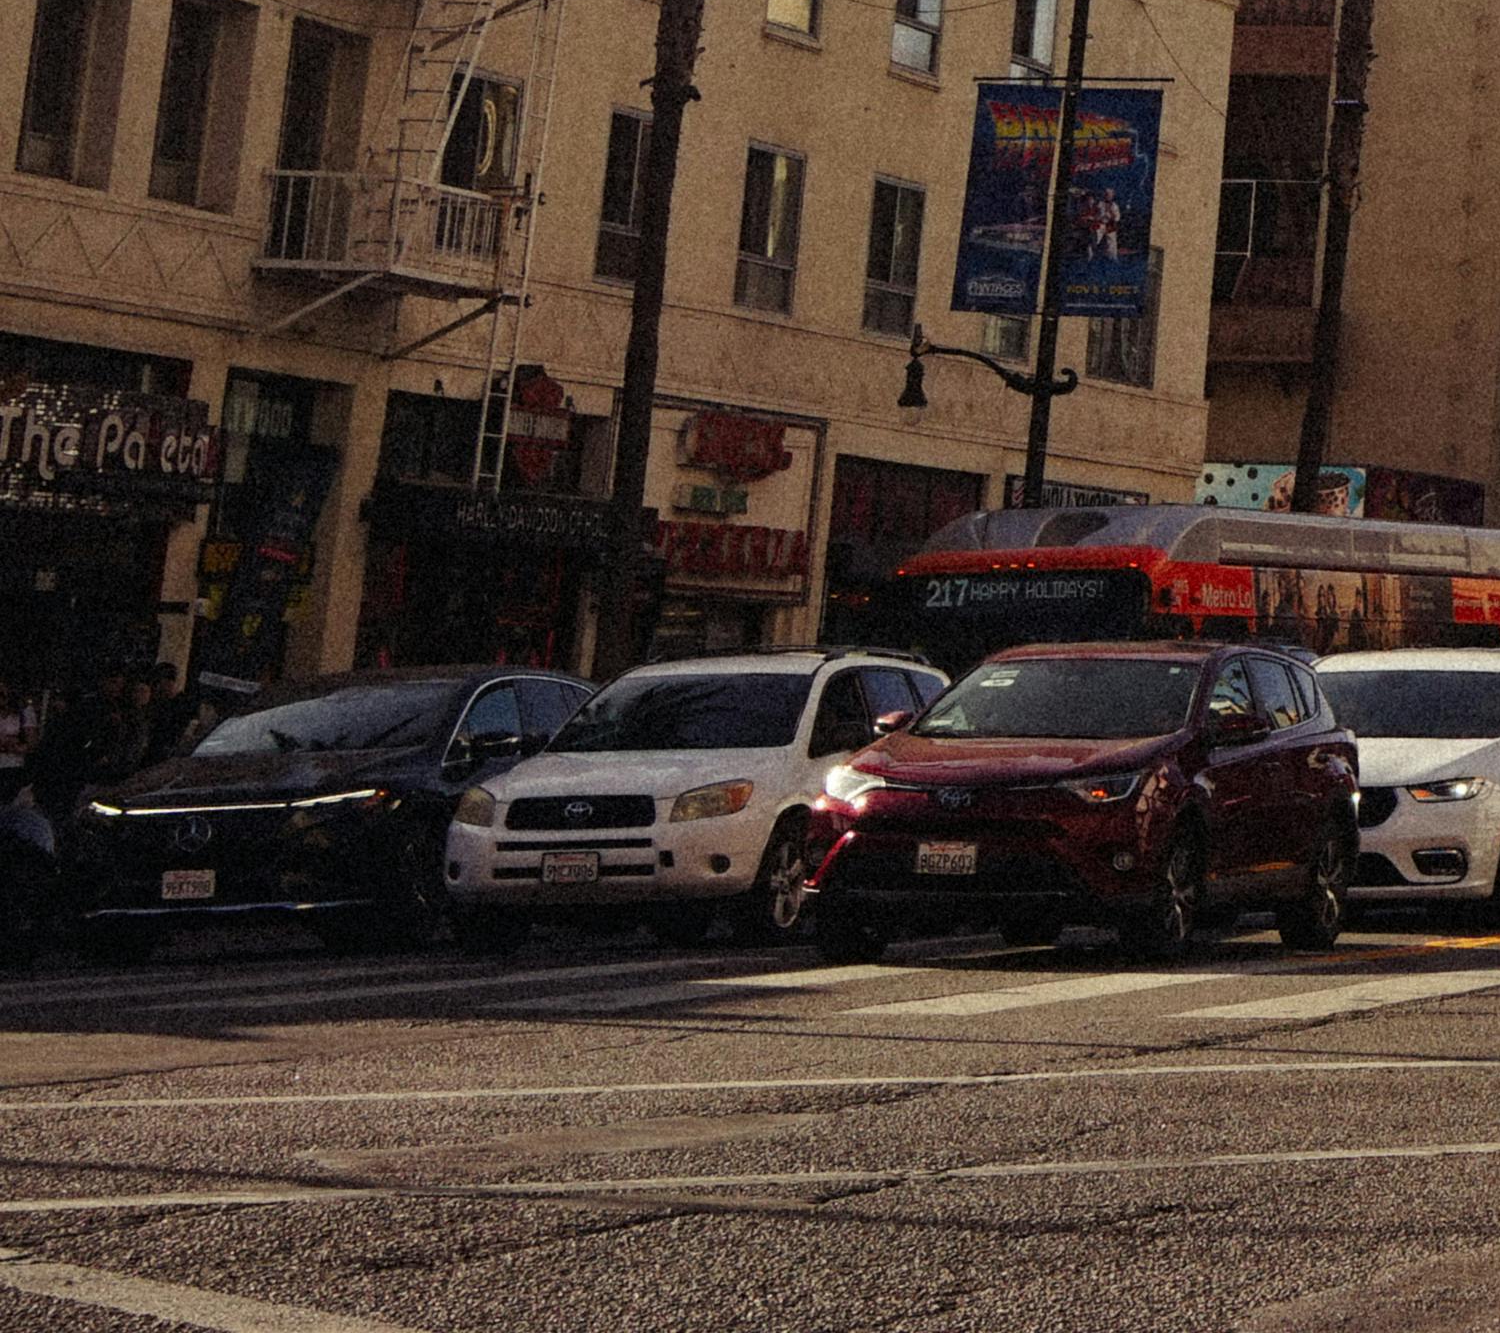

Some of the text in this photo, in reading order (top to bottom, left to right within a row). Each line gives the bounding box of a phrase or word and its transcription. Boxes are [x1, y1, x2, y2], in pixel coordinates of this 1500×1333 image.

[924, 579, 1106, 610] 217 HAPPY HOLIDAYS!
[1201, 584, 1239, 610] Metro
